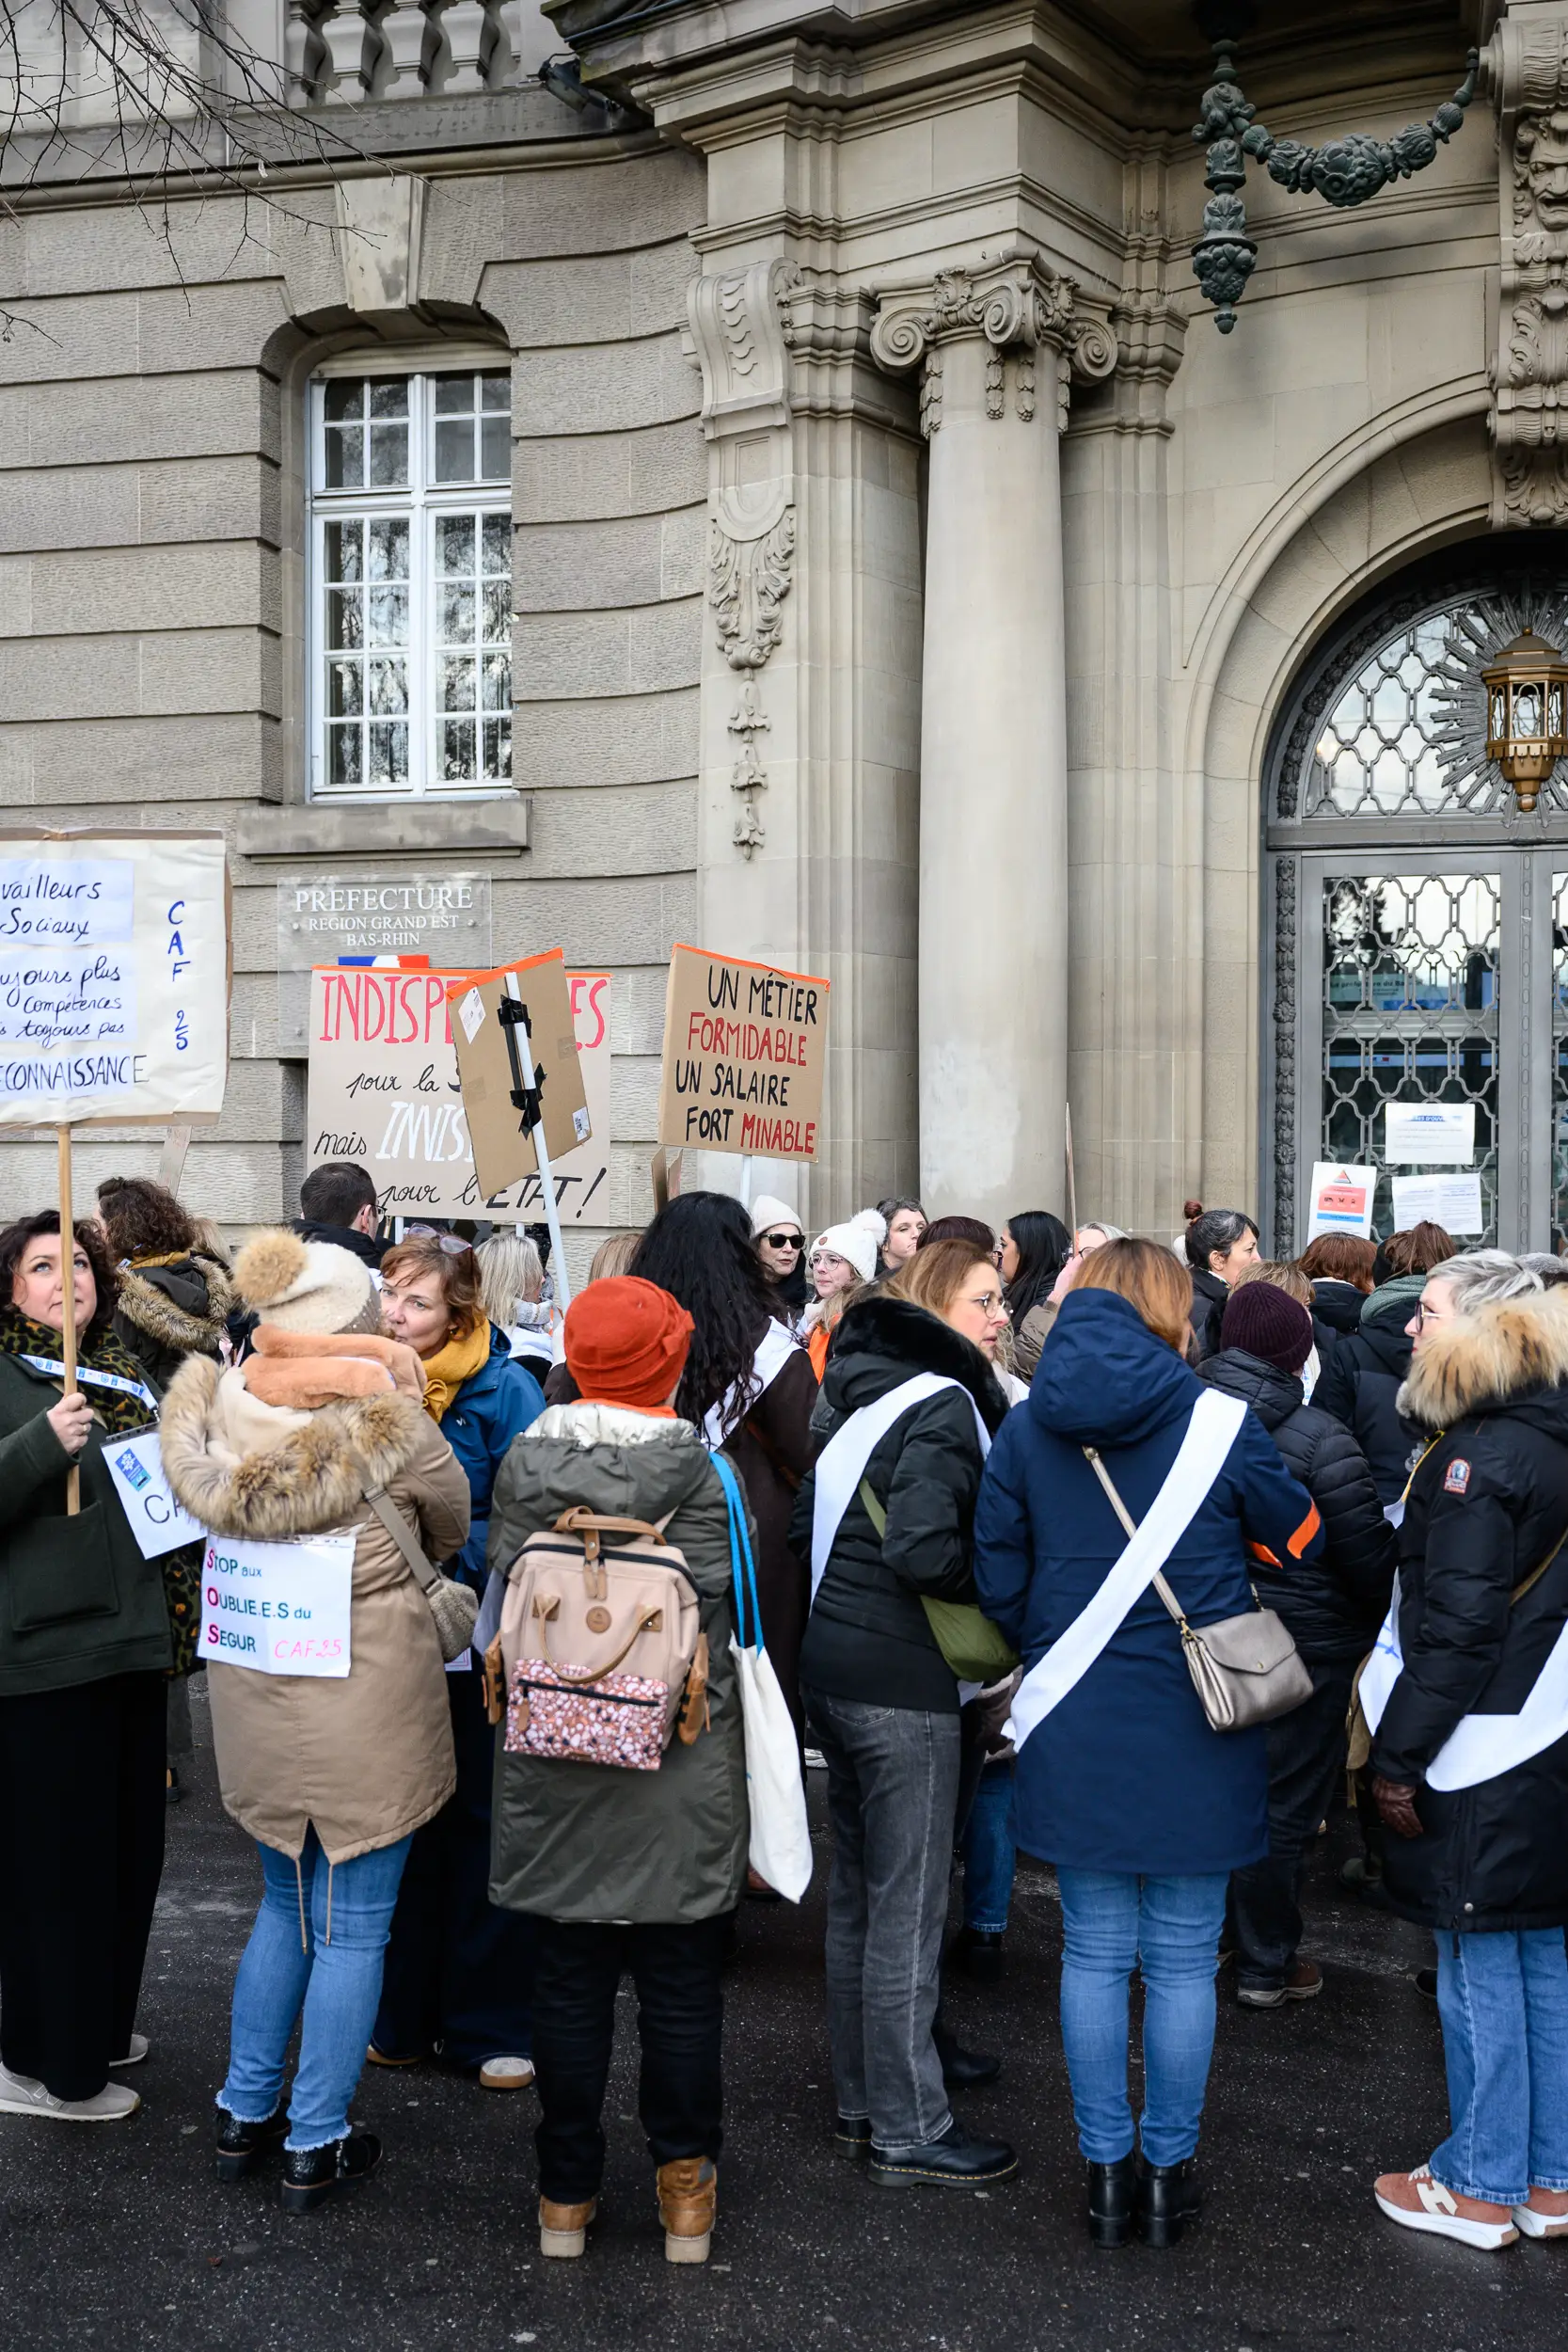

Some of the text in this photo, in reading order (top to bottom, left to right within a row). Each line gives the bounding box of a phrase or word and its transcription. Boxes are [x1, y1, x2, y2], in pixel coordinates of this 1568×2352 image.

[294, 887, 474, 913] PREFECTURE
[0, 907, 89, 943] Sociaux
[309, 914, 459, 931] REGION GRAND EST
[346, 932, 420, 946] BAS-RHIN
[80, 955, 120, 997] plus
[707, 965, 739, 1011] UN
[97, 1022, 124, 1040] pas
[688, 1011, 807, 1066] FORMIDABLE
[345, 1063, 440, 1098] pour la
[675, 1059, 790, 1106] UN SALAIRE
[313, 1130, 367, 1155] mais
[686, 1105, 816, 1154] FORT MINABLE
[377, 1184, 440, 1208] pour
[206, 1548, 262, 1577] STOP aux
[293, 1607, 311, 1619] du
[207, 1624, 257, 1653] SEGUR
